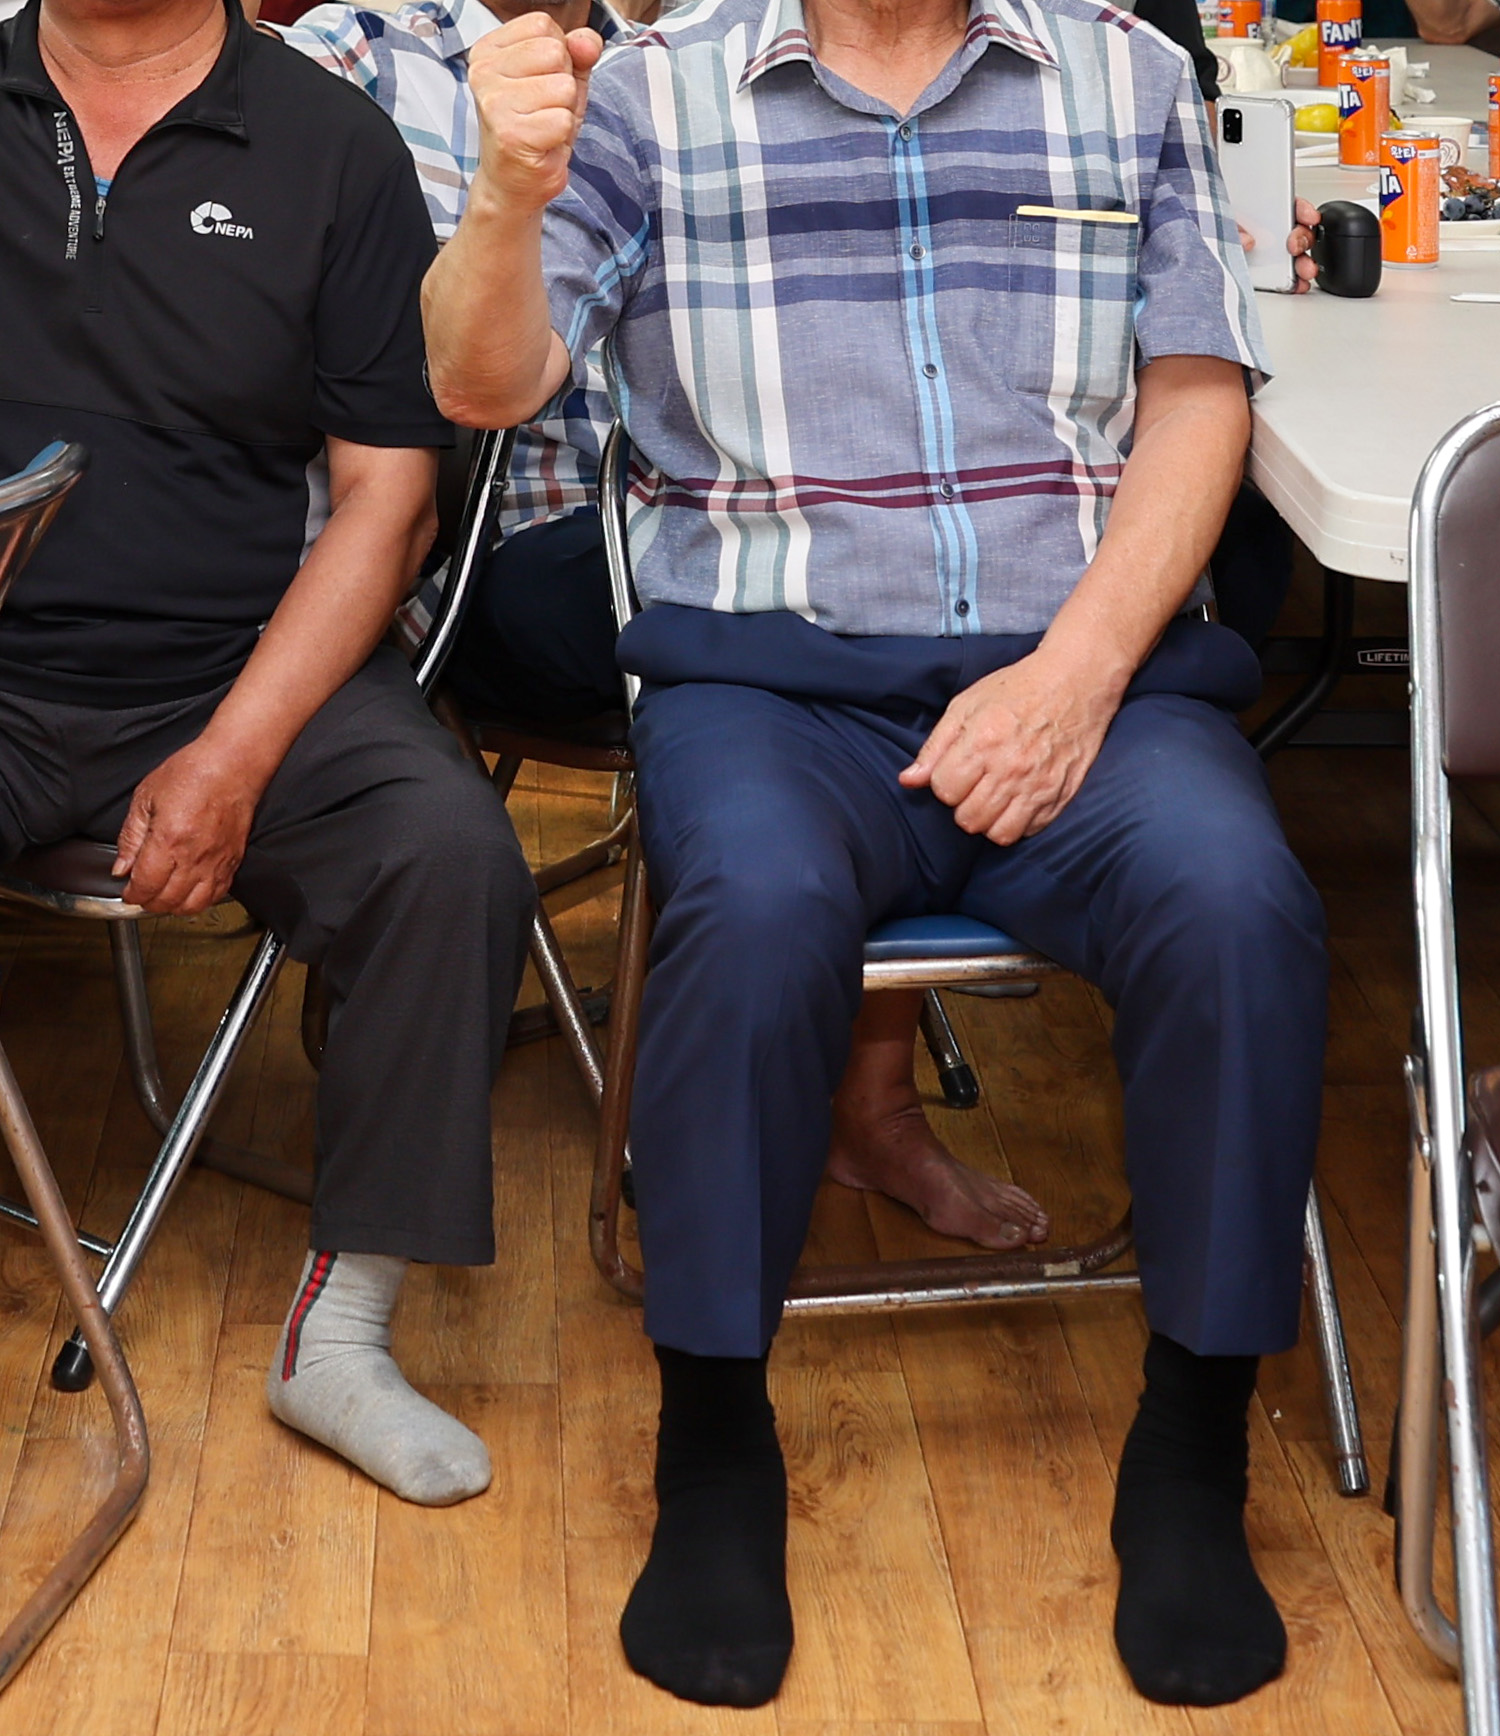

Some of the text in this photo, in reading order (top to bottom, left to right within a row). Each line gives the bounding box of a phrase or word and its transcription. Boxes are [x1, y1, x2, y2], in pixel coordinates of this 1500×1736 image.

[1321, 20, 1362, 44] FANT
[63, 165, 82, 209] EXTREME
[65, 209, 82, 261] ADVENTURE
[214, 221, 255, 240] NEPA
